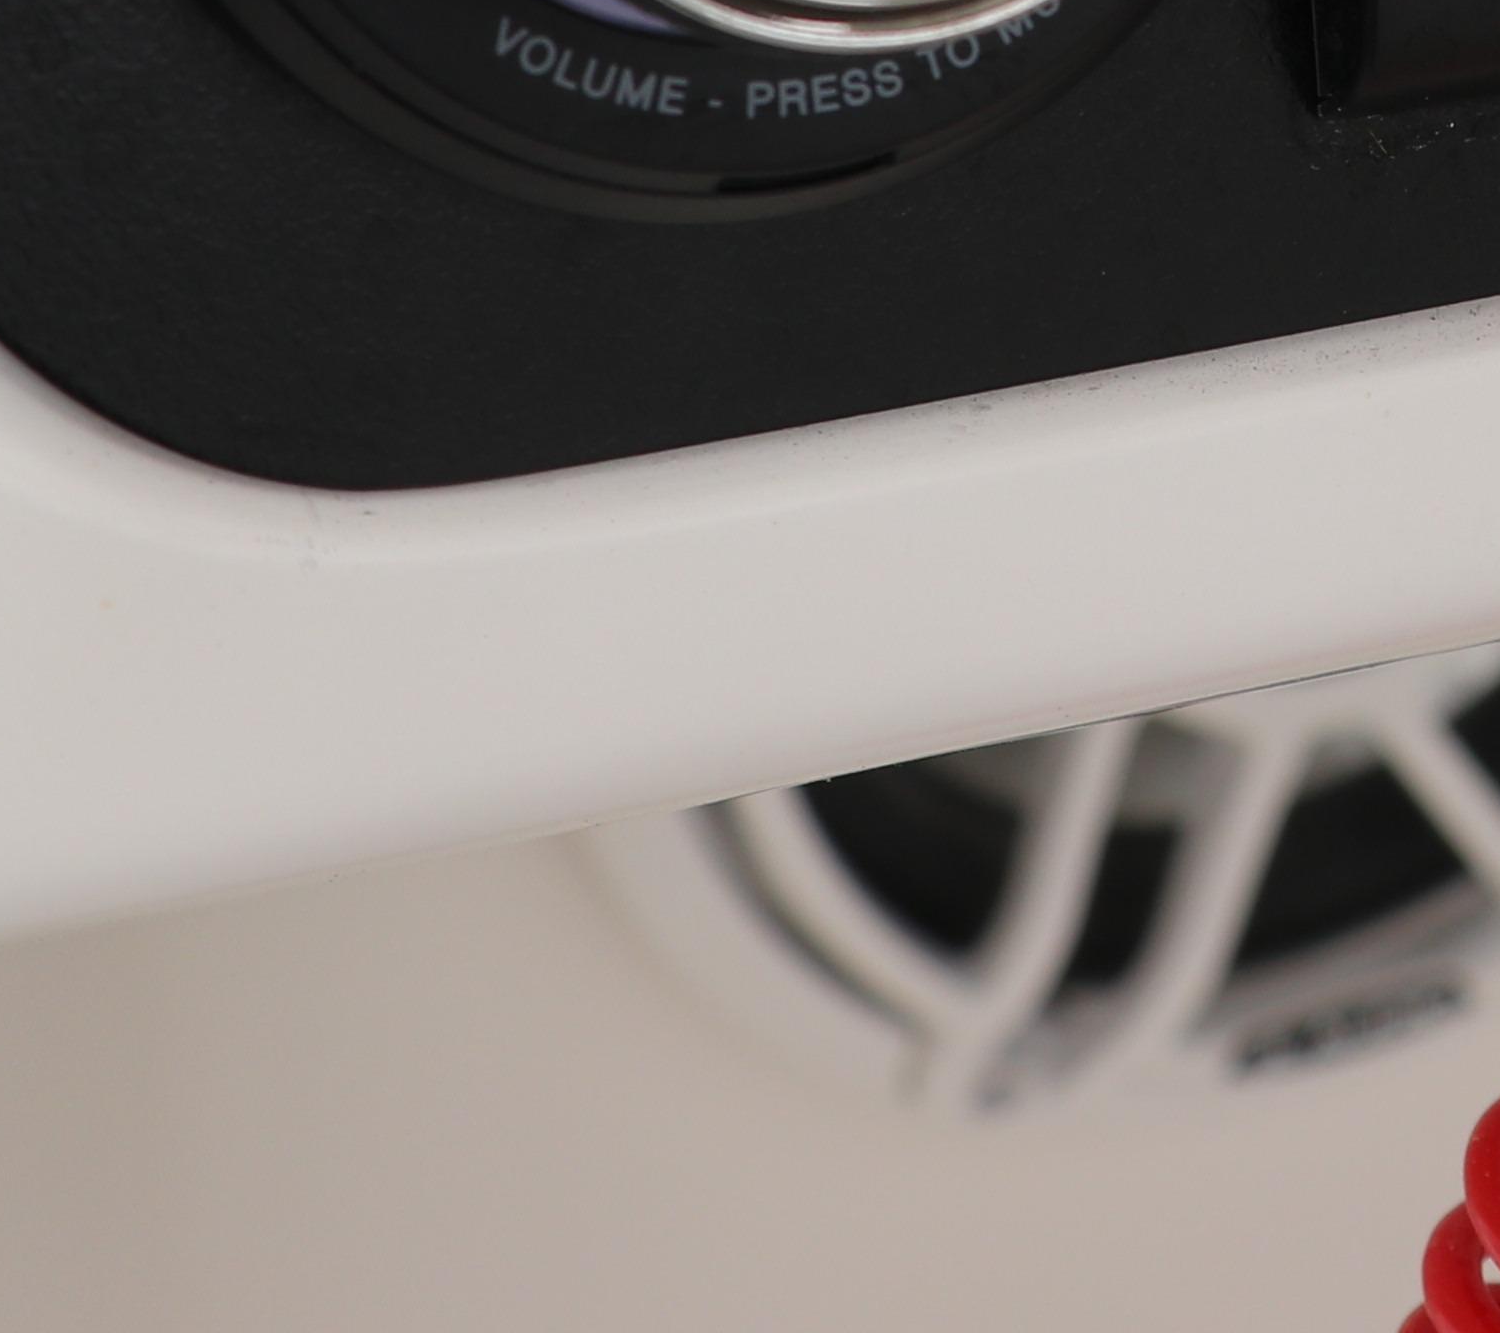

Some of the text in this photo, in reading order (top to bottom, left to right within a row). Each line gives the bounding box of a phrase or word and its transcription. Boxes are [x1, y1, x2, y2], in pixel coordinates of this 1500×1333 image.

[492, 16, 689, 116] VOLUME
[746, 60, 904, 120] PRESS
[913, 36, 983, 83] TO
